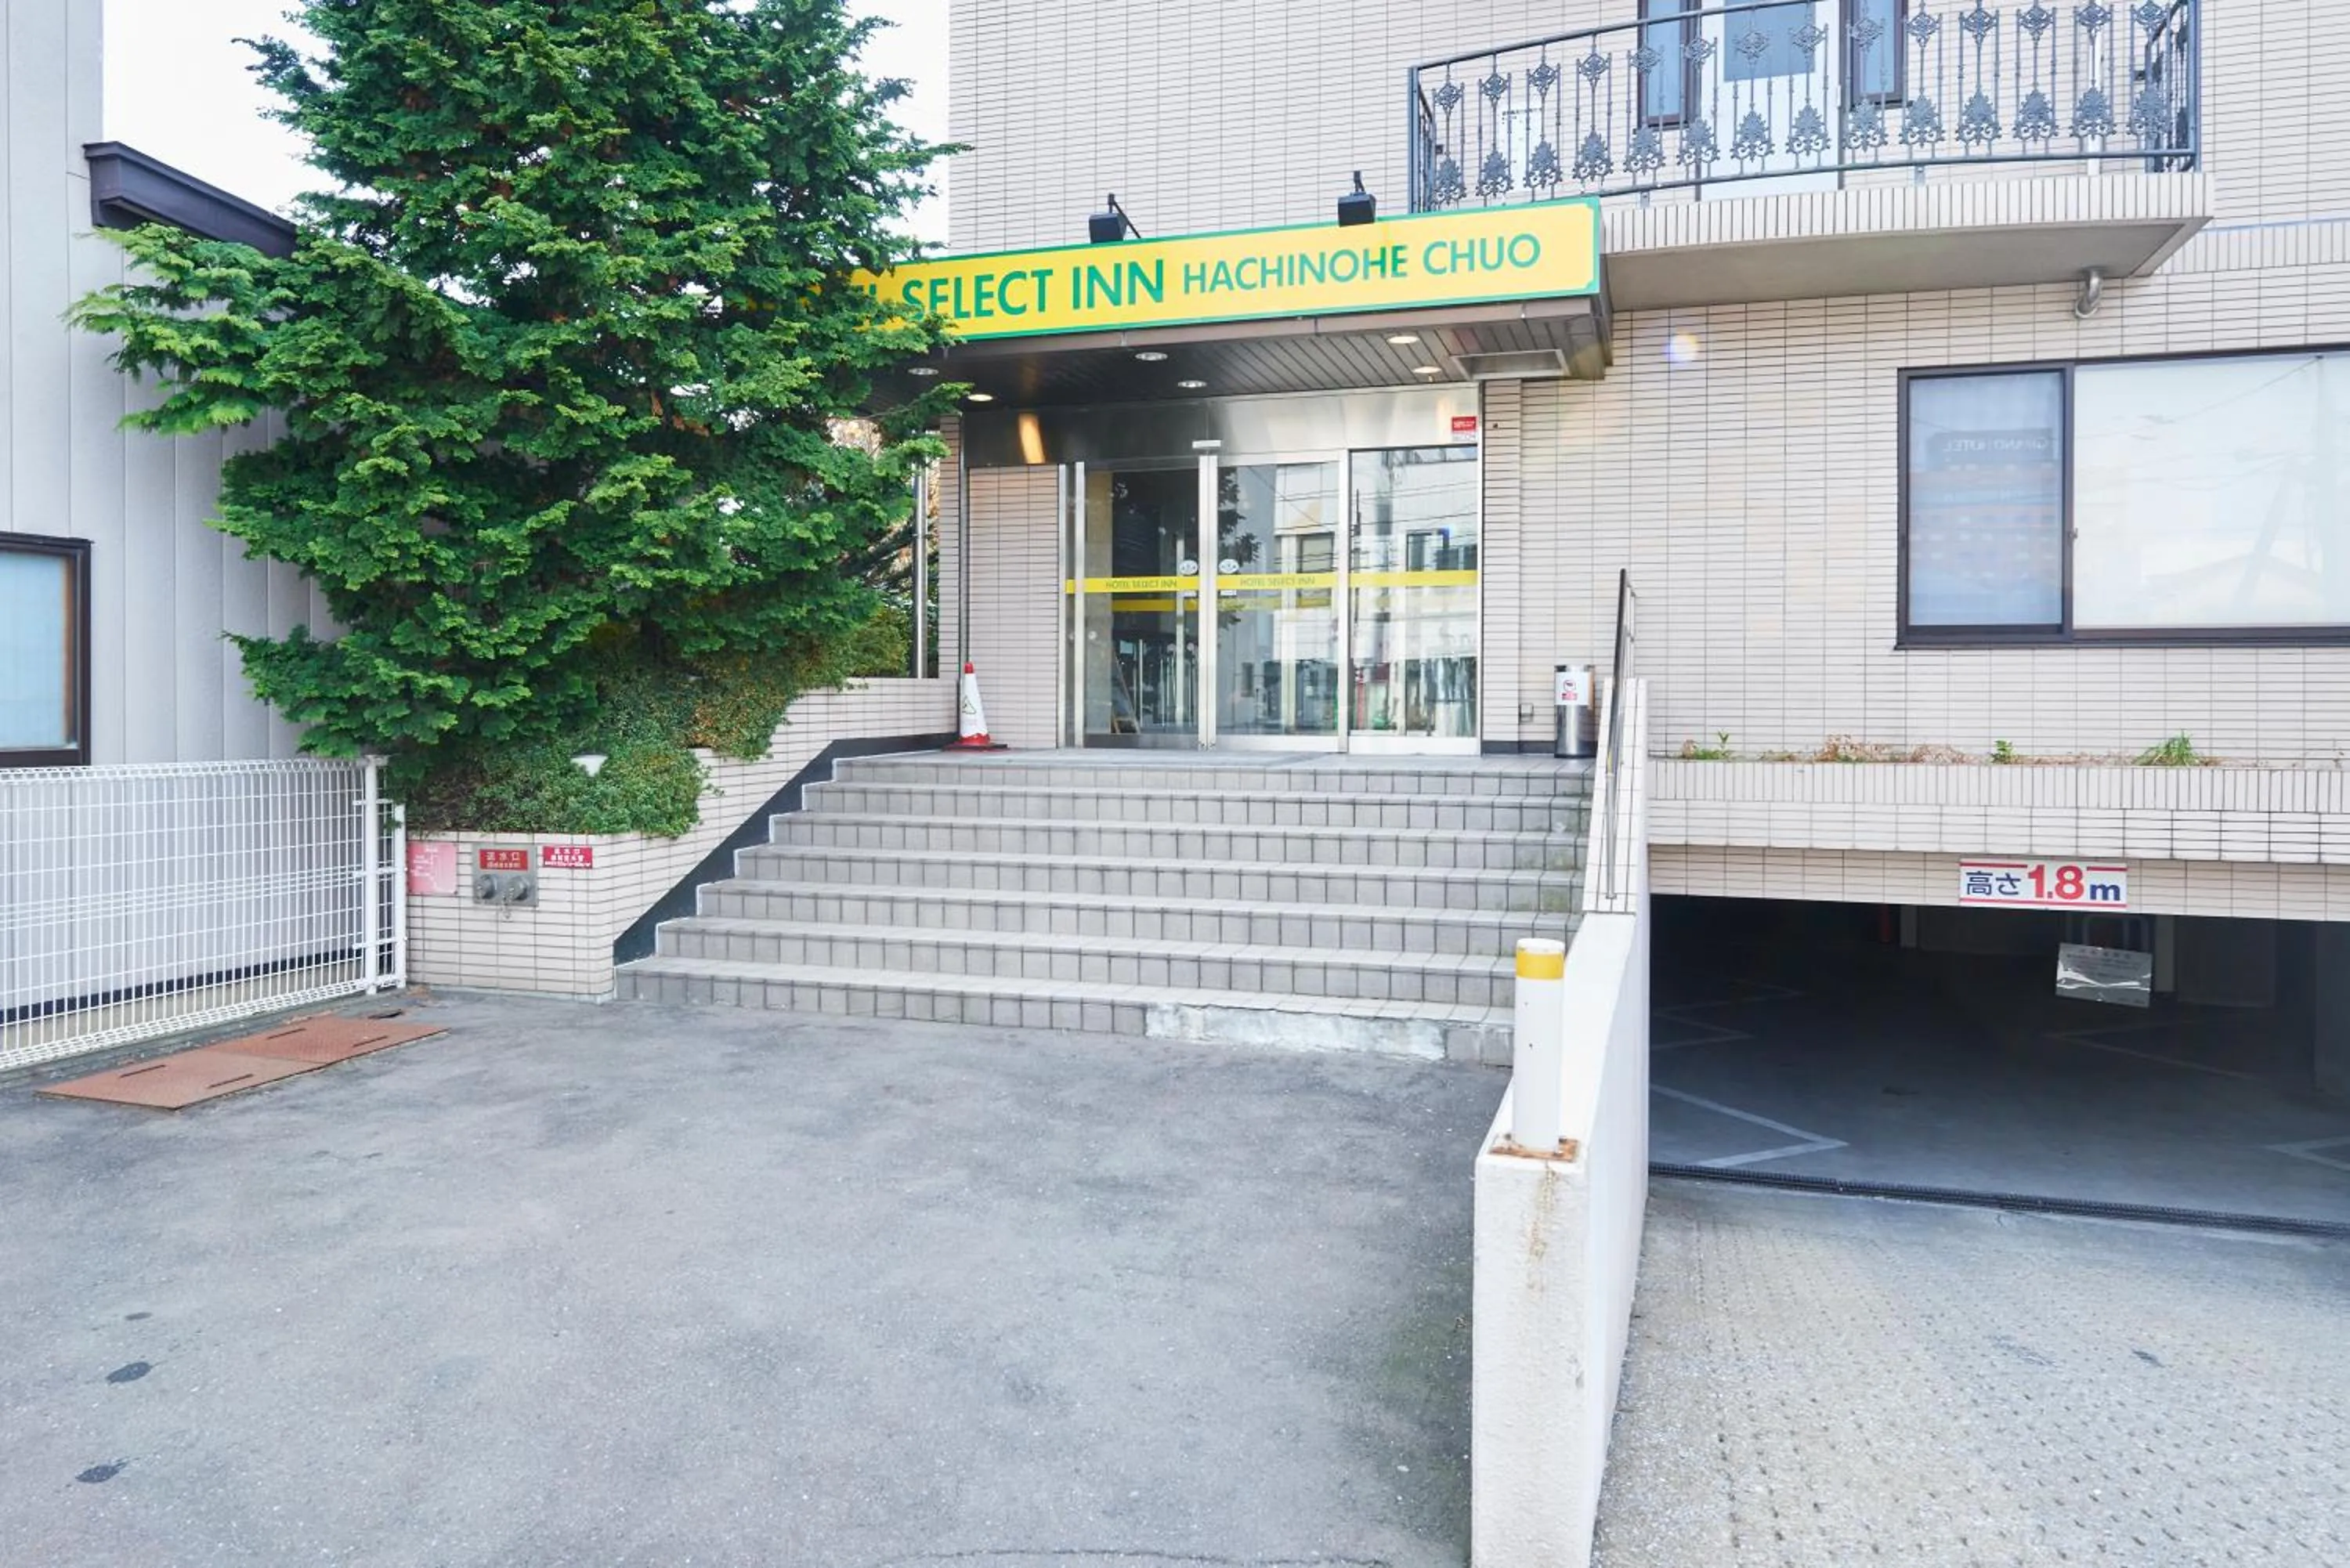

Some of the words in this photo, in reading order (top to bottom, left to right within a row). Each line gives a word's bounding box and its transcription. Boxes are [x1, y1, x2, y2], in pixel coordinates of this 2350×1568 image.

[902, 269, 1054, 320] SELECT
[1072, 258, 1164, 310] INN
[1184, 244, 1408, 294] HACHINOHE
[1423, 233, 1541, 276] CHUO
[1160, 578, 1177, 588] INN
[1298, 575, 1316, 586] INN
[1965, 864, 2121, 901] 高さ1.8m
